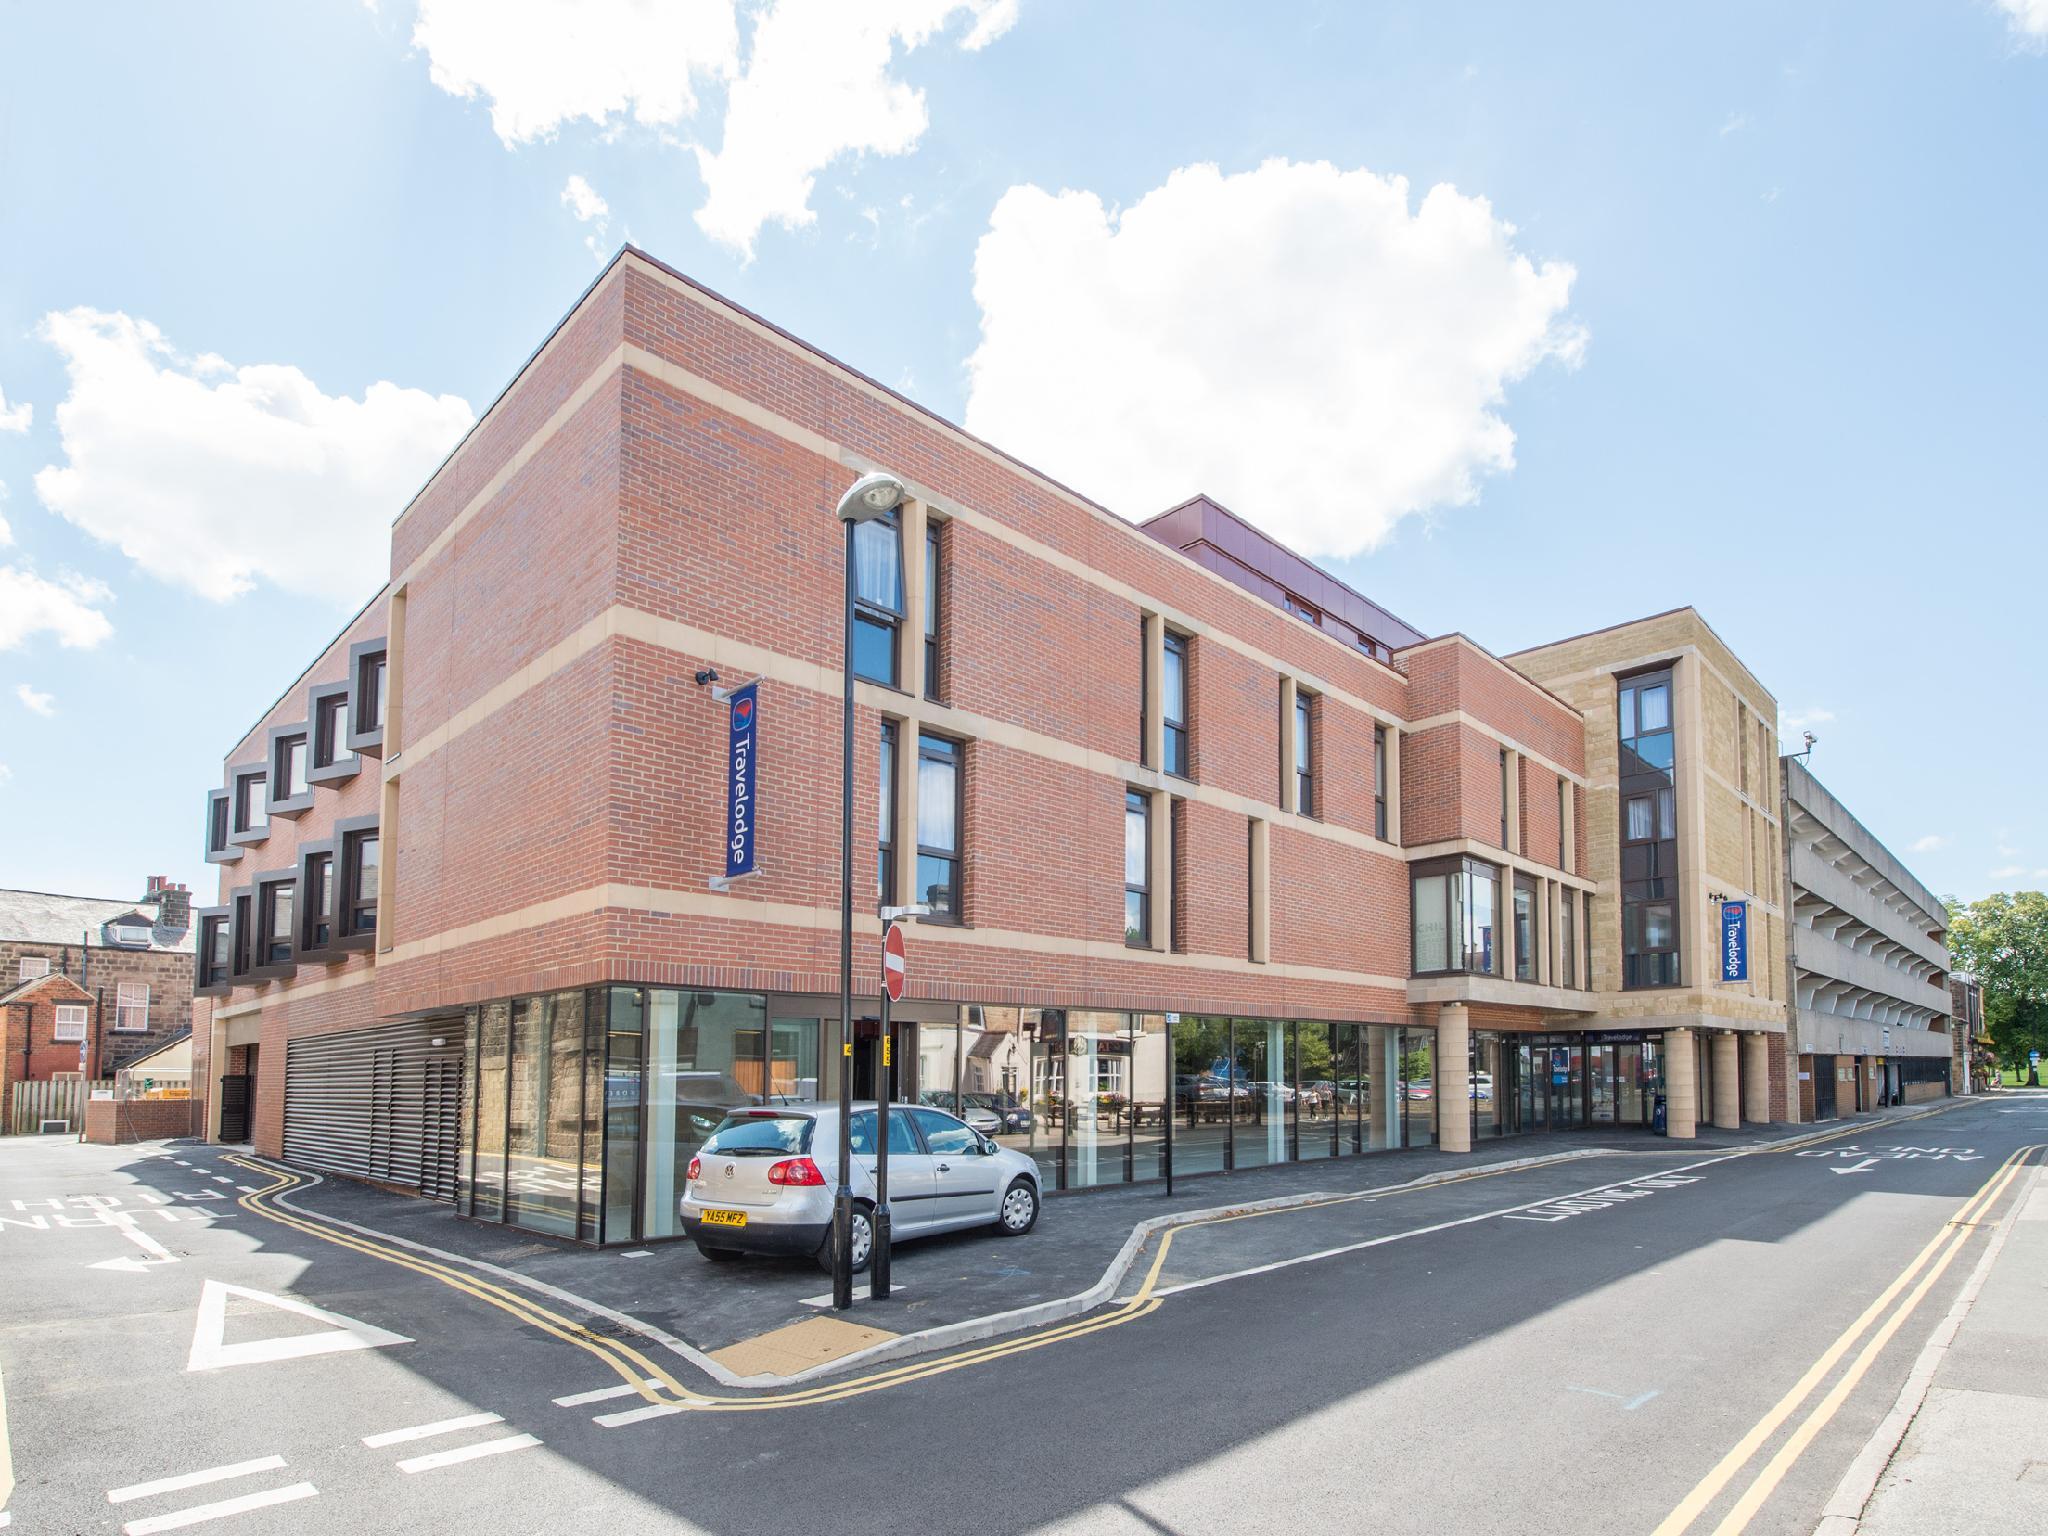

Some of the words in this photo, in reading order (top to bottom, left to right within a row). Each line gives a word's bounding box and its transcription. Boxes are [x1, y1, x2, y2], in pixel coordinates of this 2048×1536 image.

[731, 732, 750, 864] Travelodge
[1726, 921, 1741, 977] Travelodge
[1795, 1151, 1985, 1161] AHEAD
[10, 1189, 228, 1211] RIGH
[1502, 1189, 1655, 1222] LOADING
[1629, 1174, 1707, 1188] ONLY
[0, 1206, 237, 1231] TURN
[706, 1210, 725, 1223] YA55
[726, 1211, 744, 1224] MFZ
